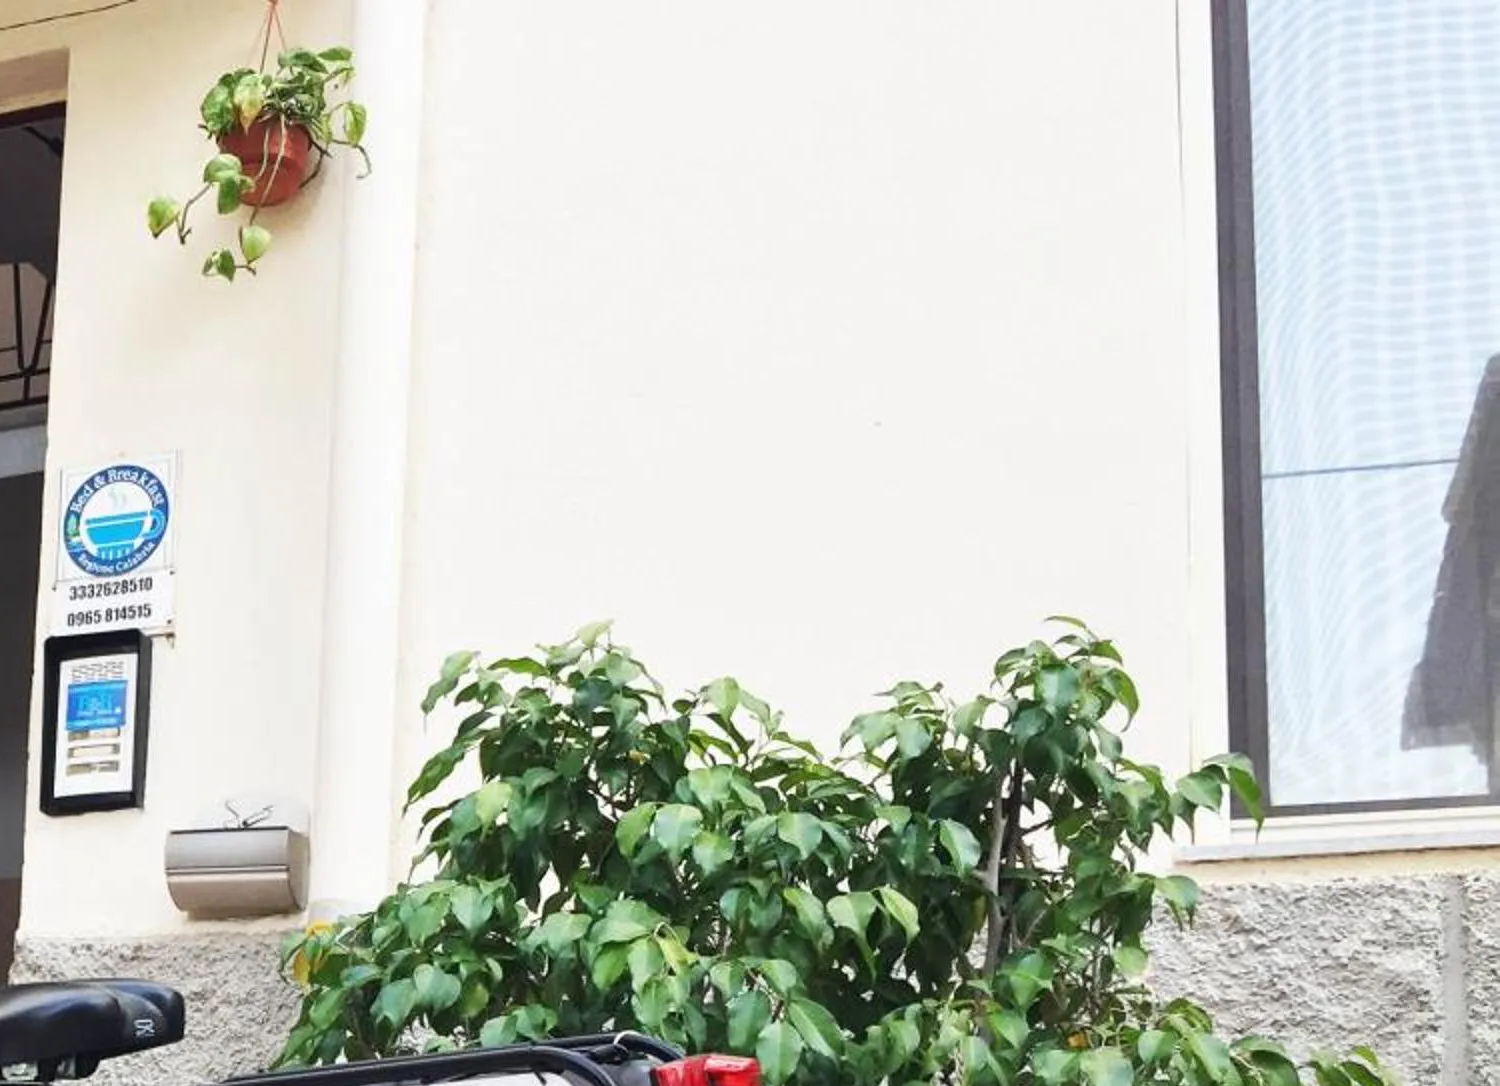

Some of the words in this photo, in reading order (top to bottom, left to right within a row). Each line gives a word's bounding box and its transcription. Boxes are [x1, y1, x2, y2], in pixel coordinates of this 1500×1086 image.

[70, 485, 94, 512] Bed
[108, 469, 164, 507] Breakfast
[69, 577, 153, 601] 3332628510
[67, 609, 101, 627] 0965
[105, 603, 152, 622] 814515
